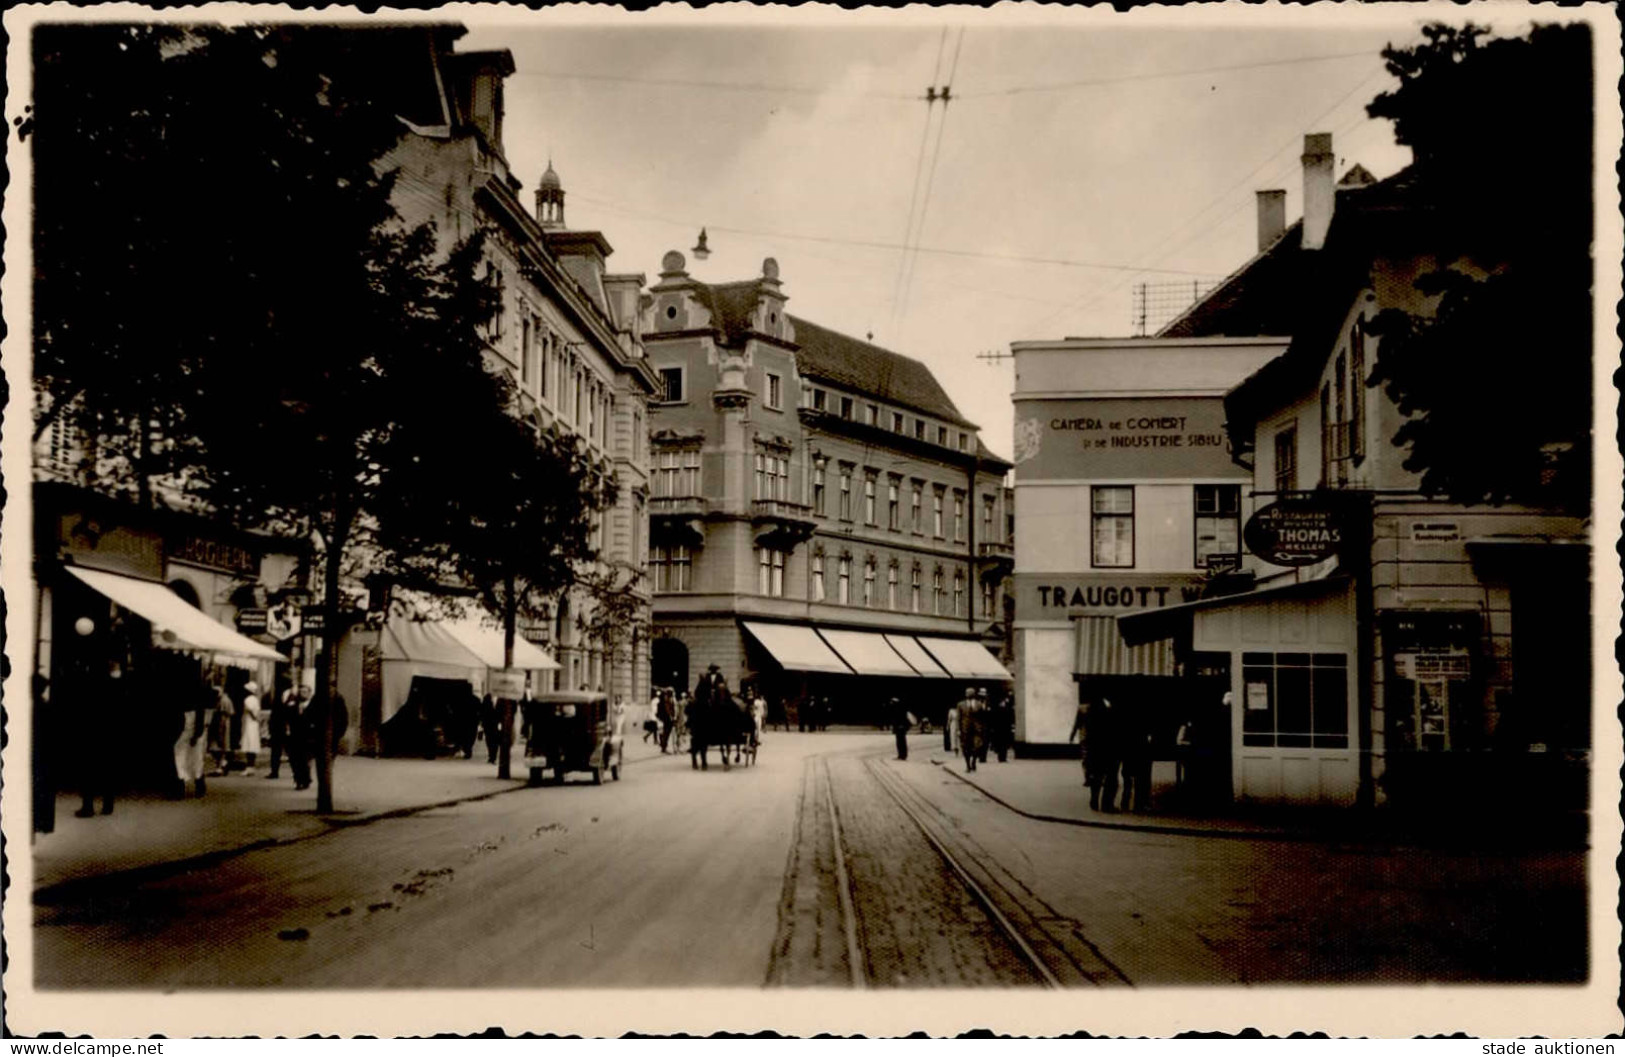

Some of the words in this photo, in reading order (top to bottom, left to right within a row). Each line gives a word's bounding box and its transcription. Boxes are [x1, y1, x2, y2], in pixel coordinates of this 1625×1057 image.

[1050, 418, 1103, 431] CAMERA
[1111, 435, 1182, 447] INDUSTRIE
[1187, 434, 1222, 447] SIBIU
[1277, 528, 1341, 543] THOMAS
[1037, 586, 1170, 607] TRAUGOTT
